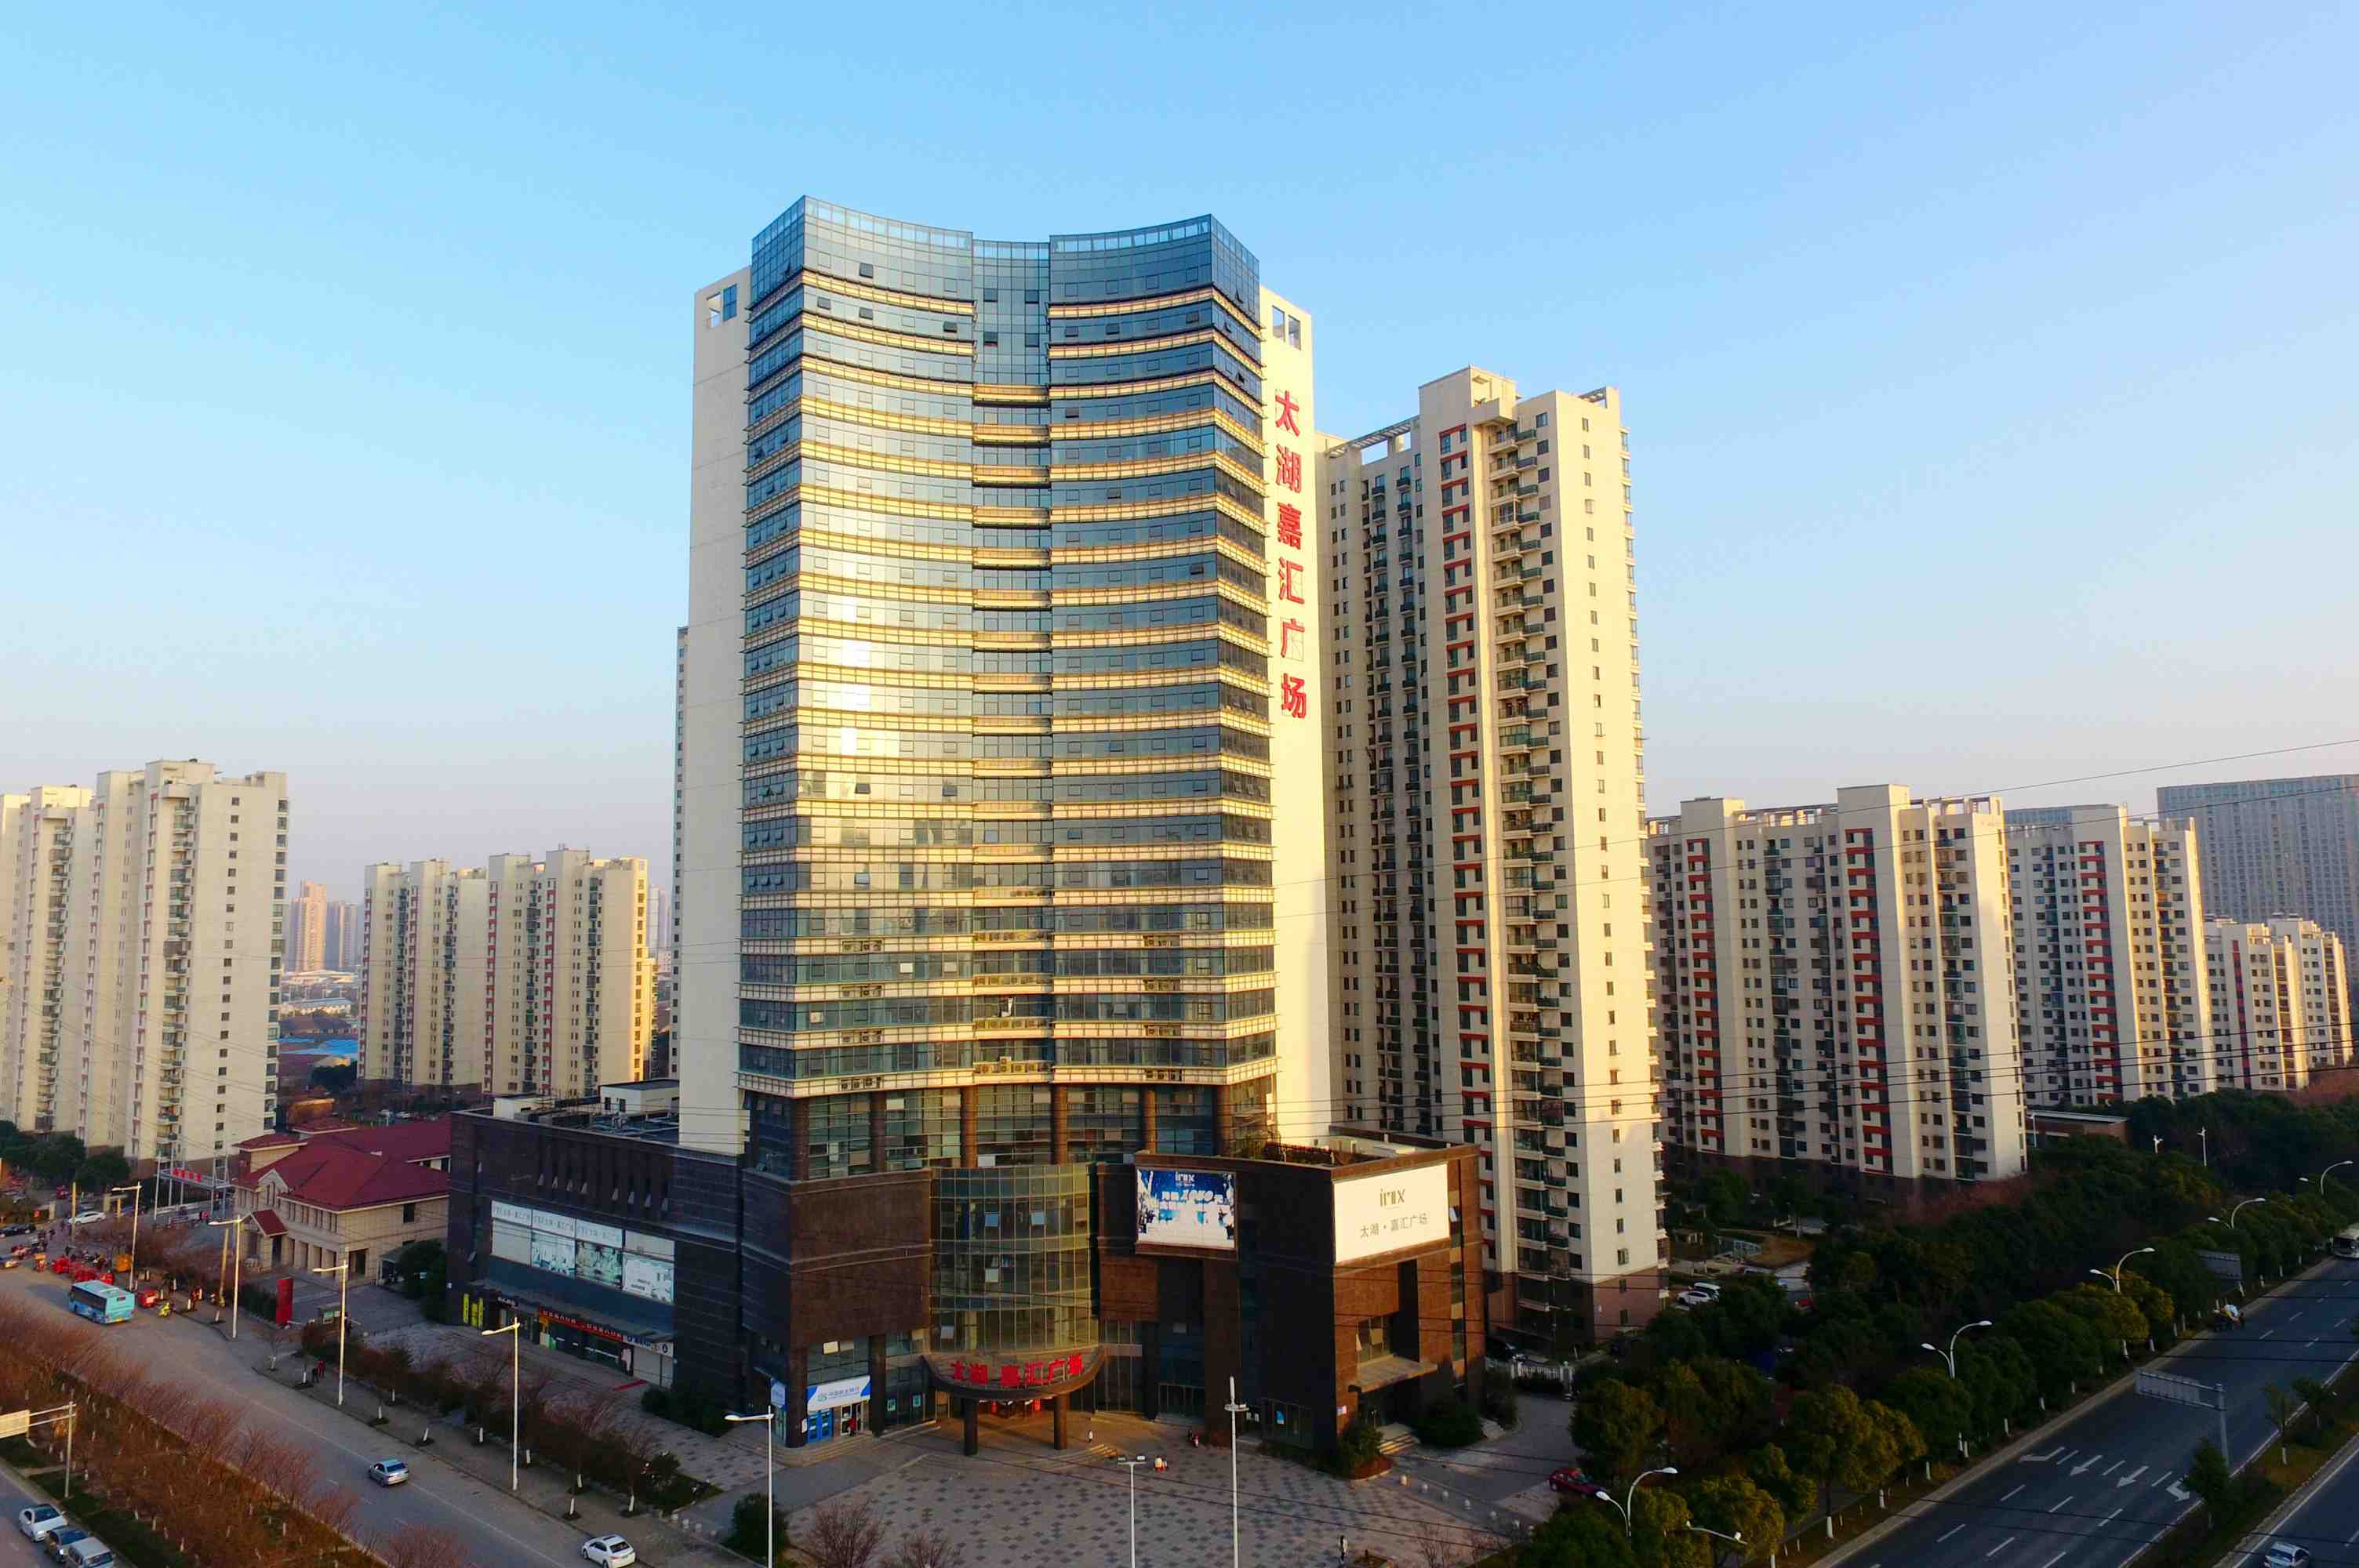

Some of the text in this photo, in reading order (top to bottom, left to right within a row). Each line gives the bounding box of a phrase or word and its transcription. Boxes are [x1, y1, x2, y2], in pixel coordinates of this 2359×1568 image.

[1275, 390, 1307, 719] 太湖嘉汇广场
